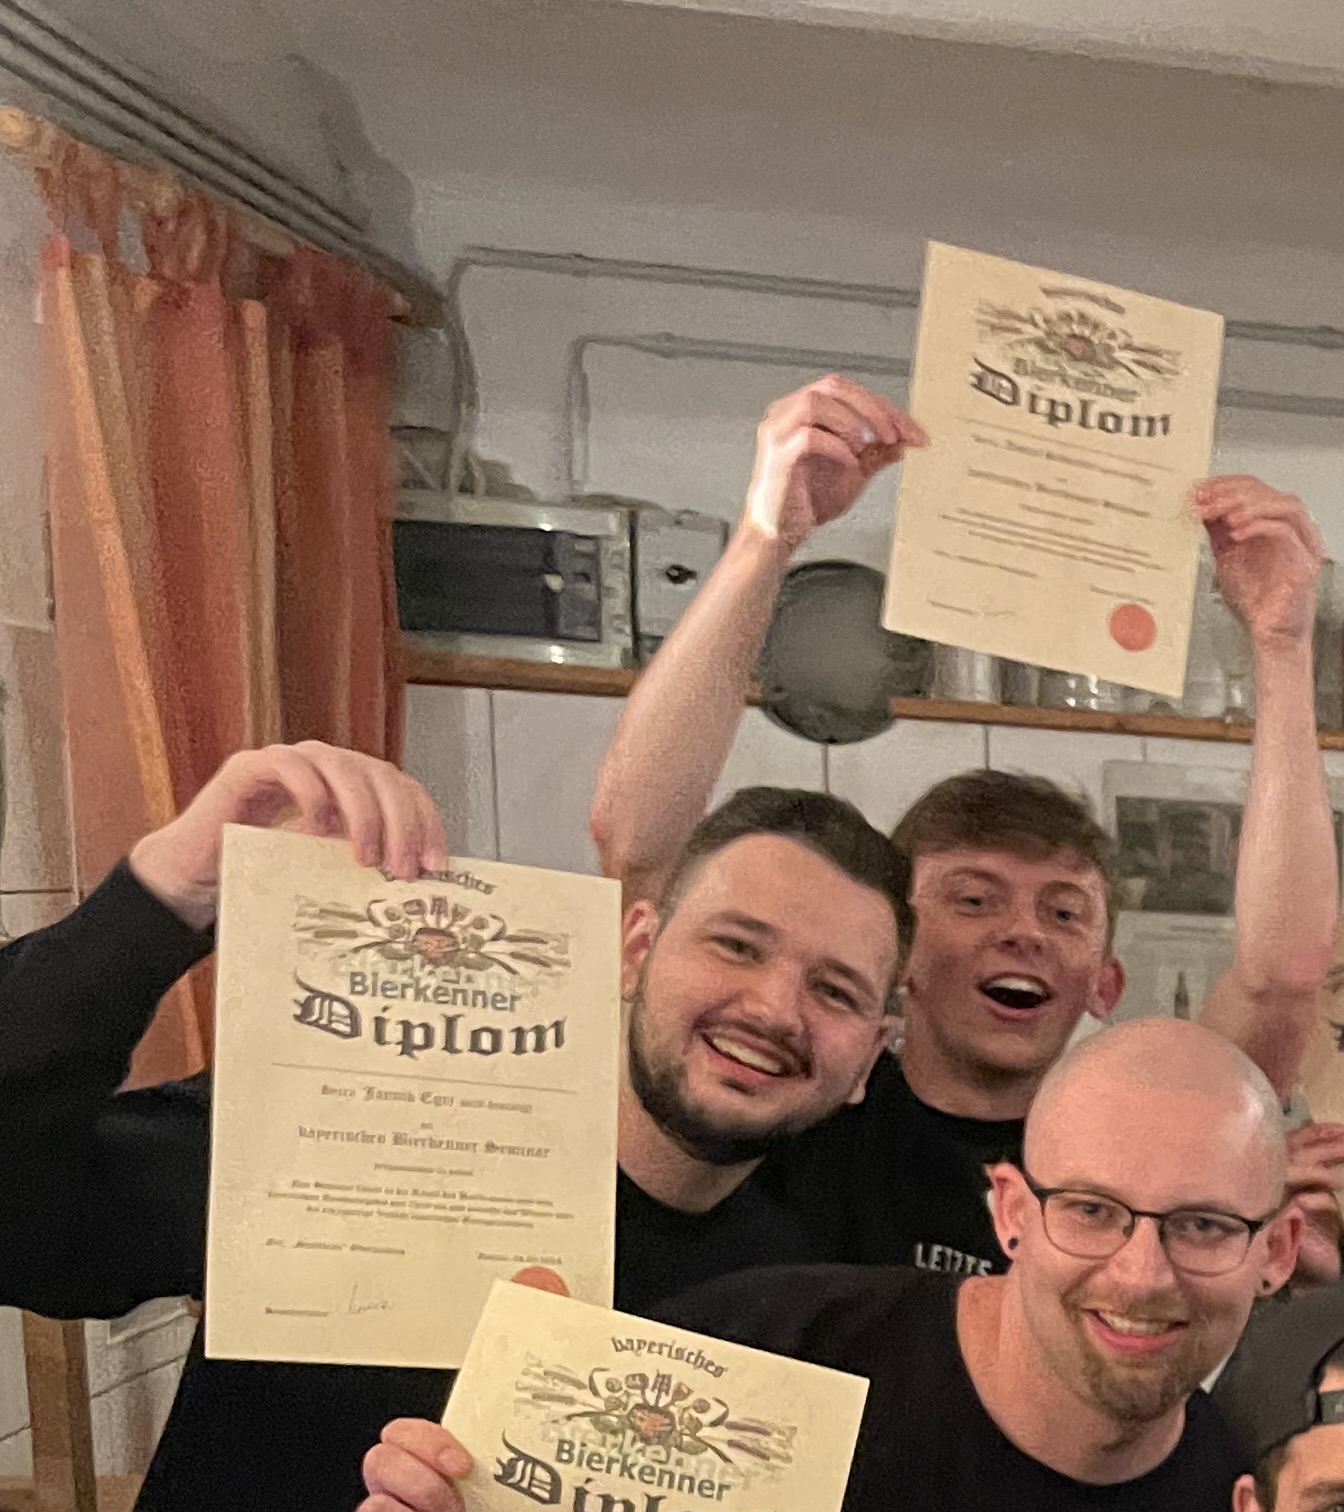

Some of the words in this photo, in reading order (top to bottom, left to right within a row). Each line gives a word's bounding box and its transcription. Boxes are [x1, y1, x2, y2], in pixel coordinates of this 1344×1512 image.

[970, 353, 1172, 439] Diplom
[291, 966, 568, 1061] Diplom
[349, 970, 522, 1013] Bierkenner
[611, 1336, 729, 1378] bayerisches
[554, 1438, 732, 1502] Bierkenner
